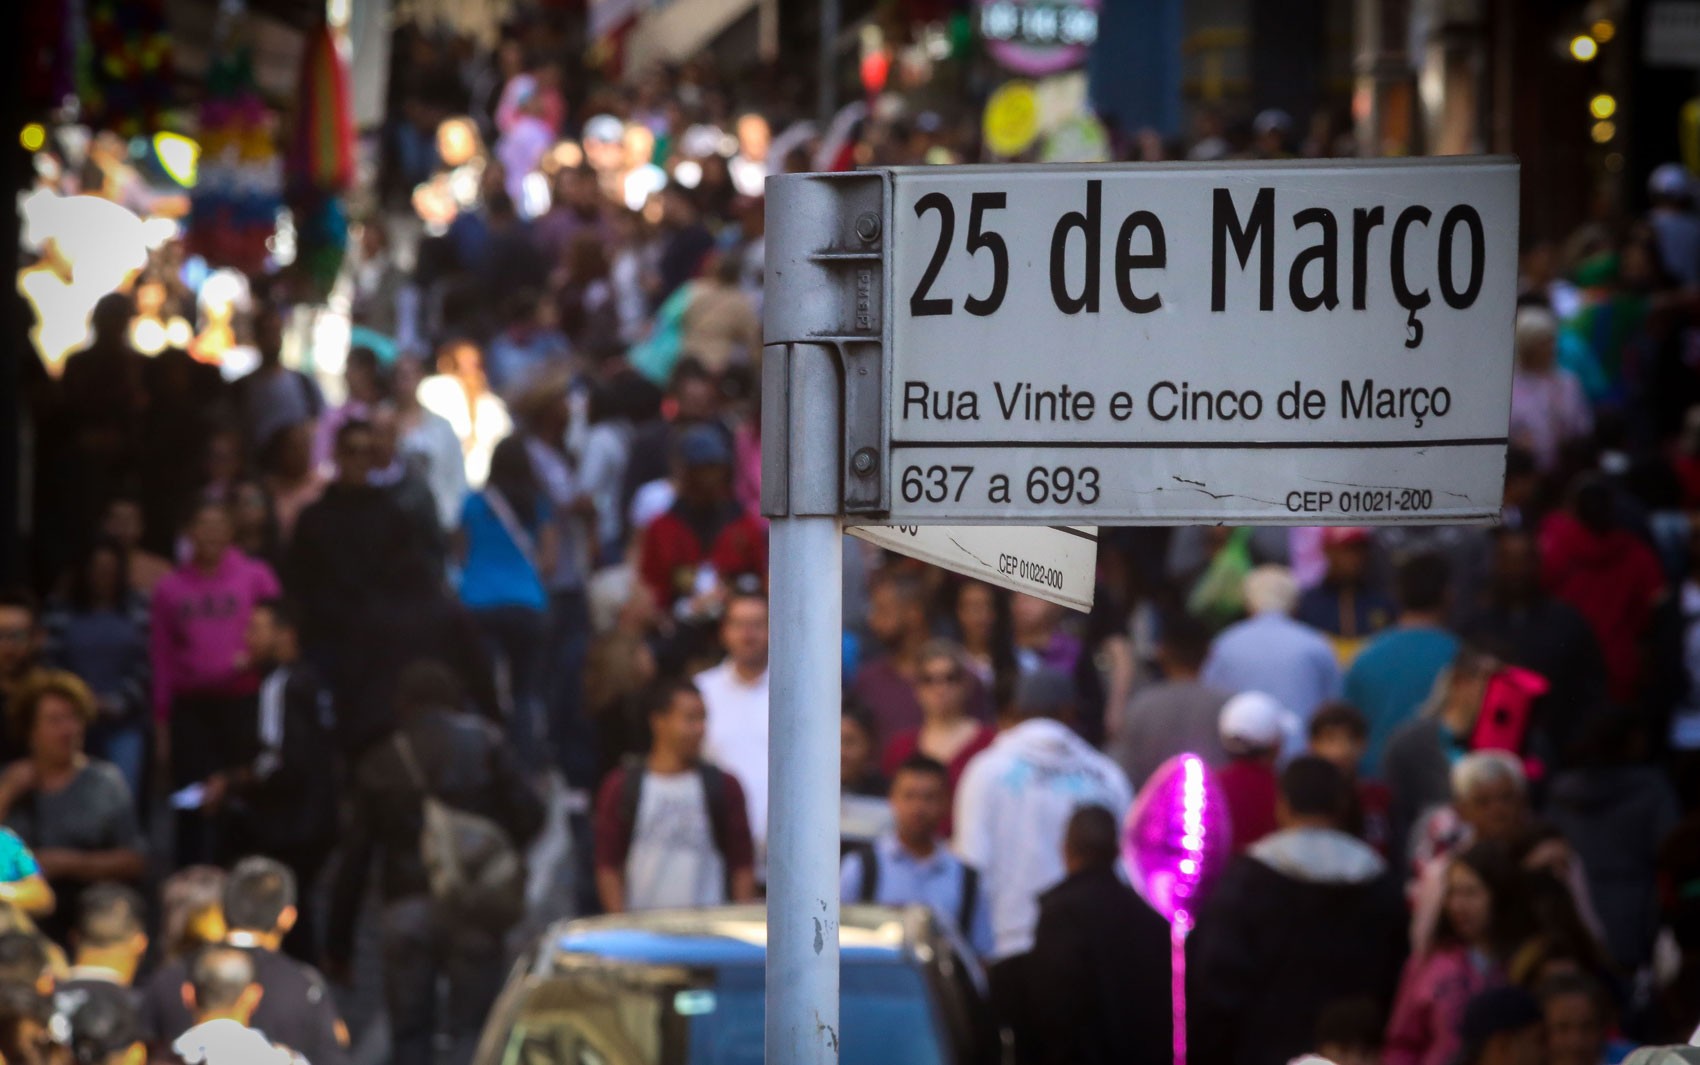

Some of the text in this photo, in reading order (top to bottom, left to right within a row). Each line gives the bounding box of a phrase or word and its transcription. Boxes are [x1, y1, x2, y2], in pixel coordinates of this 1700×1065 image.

[909, 179, 1487, 350] 25 de Março
[902, 378, 1452, 429] Rua Vinte e Cinco de Março
[901, 464, 1100, 505] 637 a 693
[1286, 489, 1432, 512] CEP 01021-200
[999, 553, 1063, 590] CEP 01022-000
